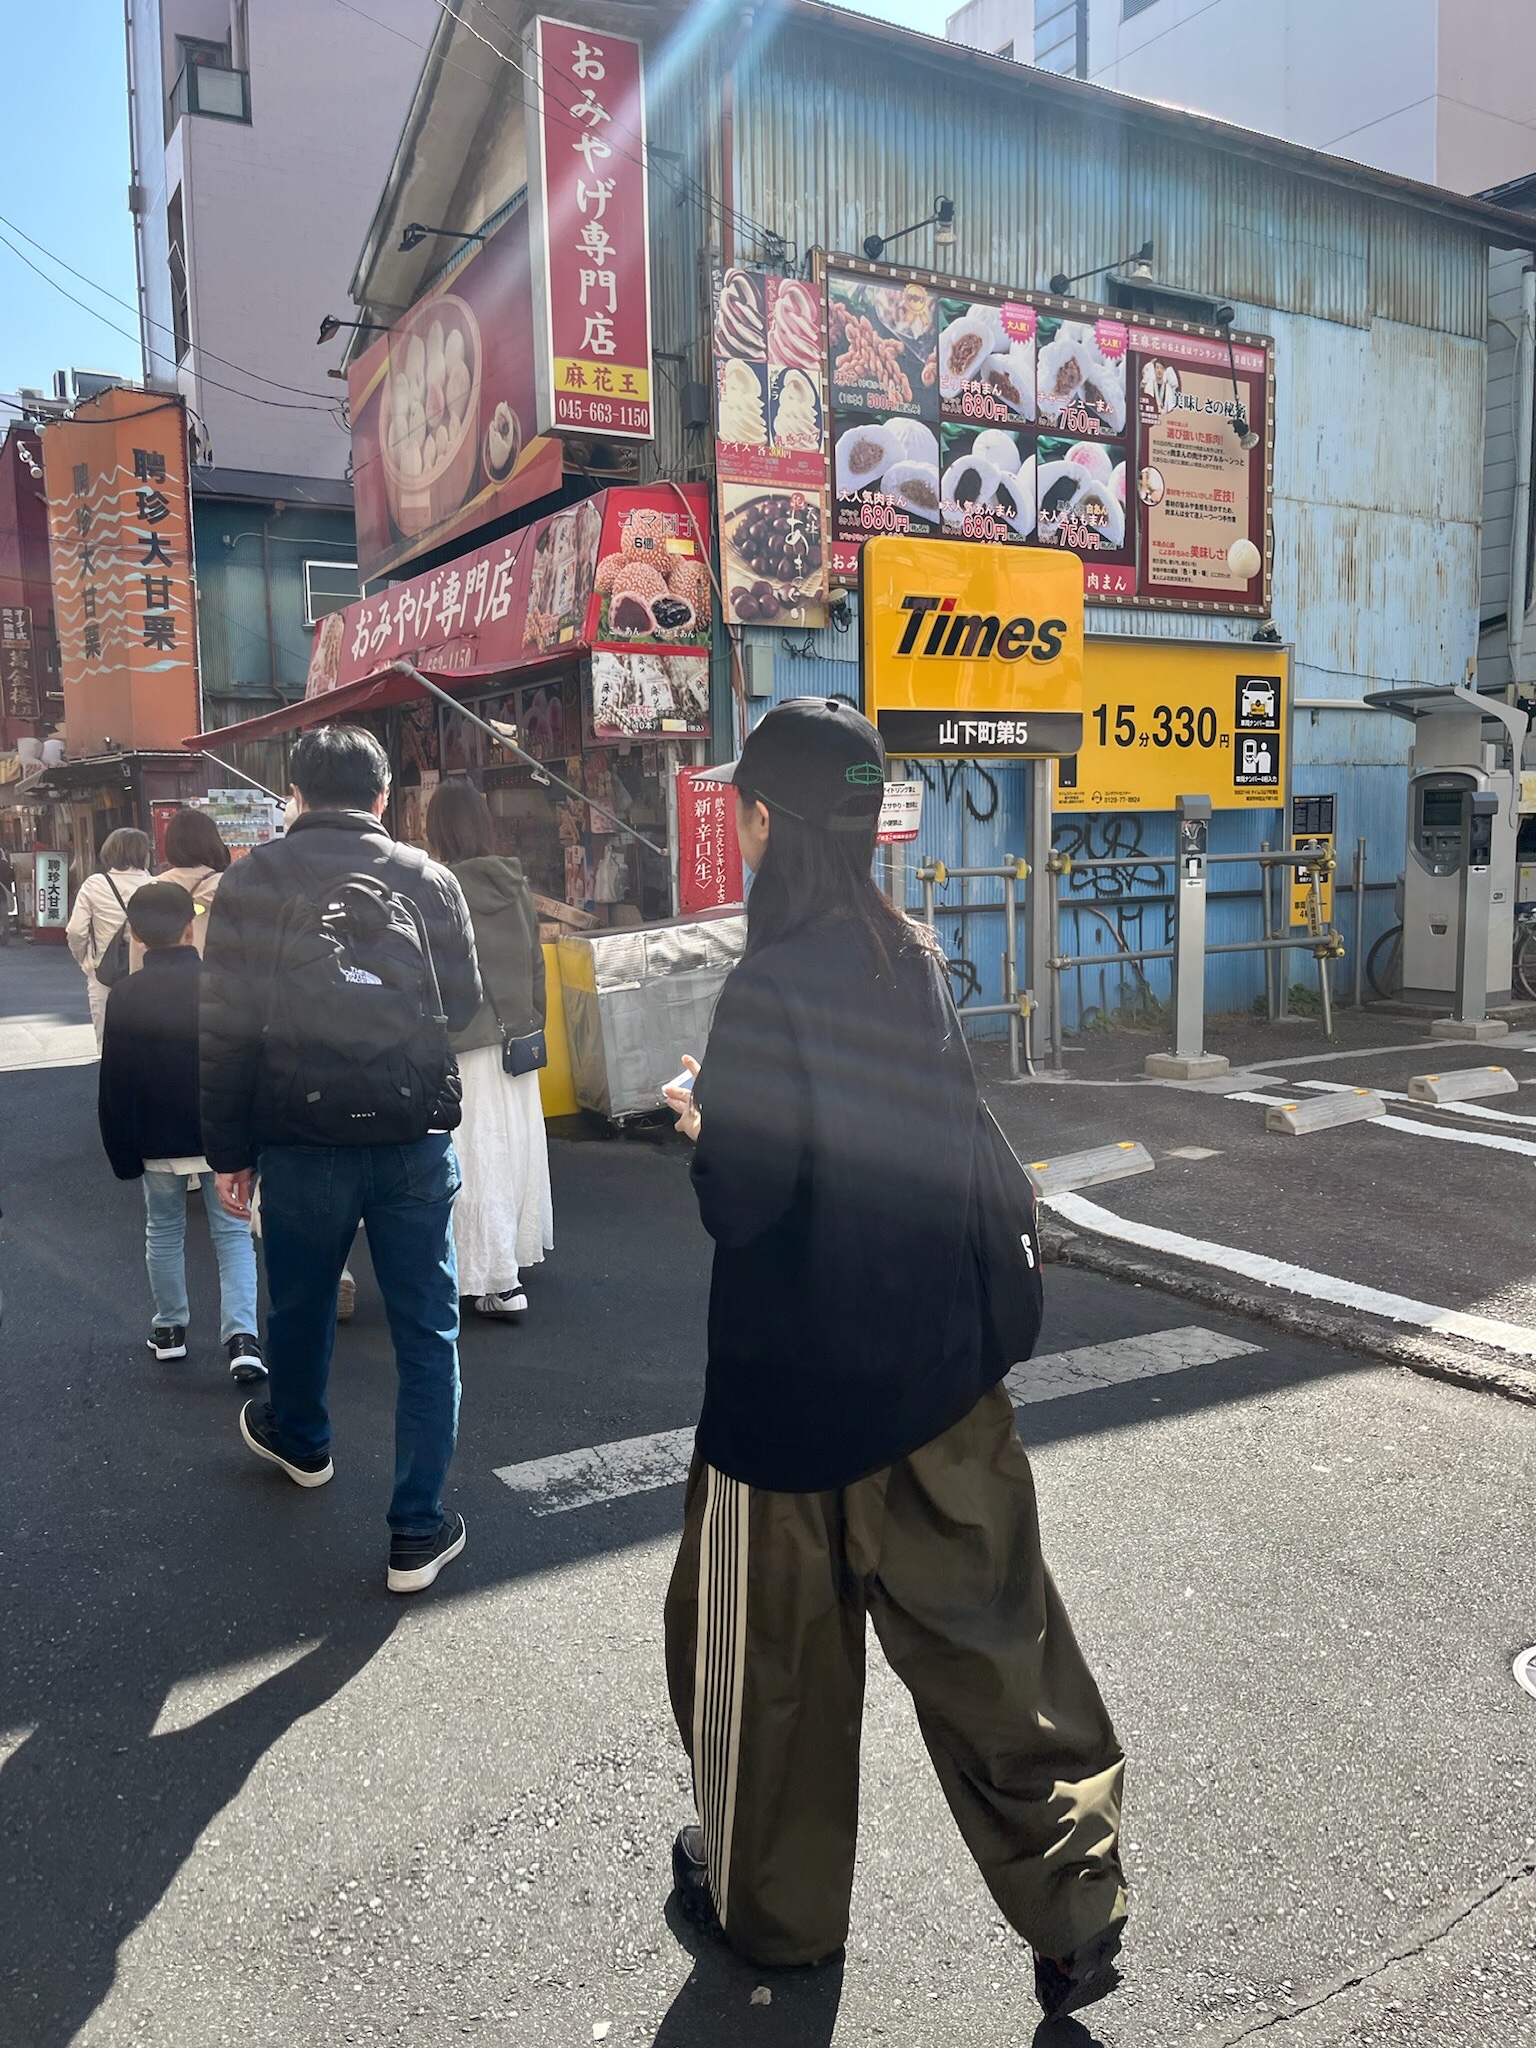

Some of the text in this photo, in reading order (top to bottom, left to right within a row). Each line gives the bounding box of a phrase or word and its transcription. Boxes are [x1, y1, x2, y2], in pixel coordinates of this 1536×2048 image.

[571, 39, 617, 356] おみやげ専門店
[565, 363, 640, 395] 麻花王
[940, 375, 1002, 396] ピリ辛肉まん
[559, 399, 649, 429] 045-663-1150
[962, 393, 1008, 423] 680円
[1059, 407, 1100, 436] 750円
[721, 442, 751, 453] アイス
[769, 446, 792, 459] 300円
[839, 488, 907, 507] 大人気肉まん
[942, 500, 1017, 519] 大人気あんまん
[861, 504, 910, 533] 680円
[962, 515, 1008, 542] 680円
[1040, 508, 1109, 527] 大人気ももまん
[133, 447, 178, 651] 聘珍大甘栗
[634, 537, 654, 550] 6個
[1059, 523, 1100, 550] 750円
[1087, 572, 1127, 591] 肉まん
[352, 548, 516, 662] おみやげ専門店
[897, 596, 1067, 660] Times
[627, 704, 653, 719] 麻花
[939, 719, 1028, 745] 山下町第5
[714, 797, 726, 904] 飲みごたえとキレのよさ
